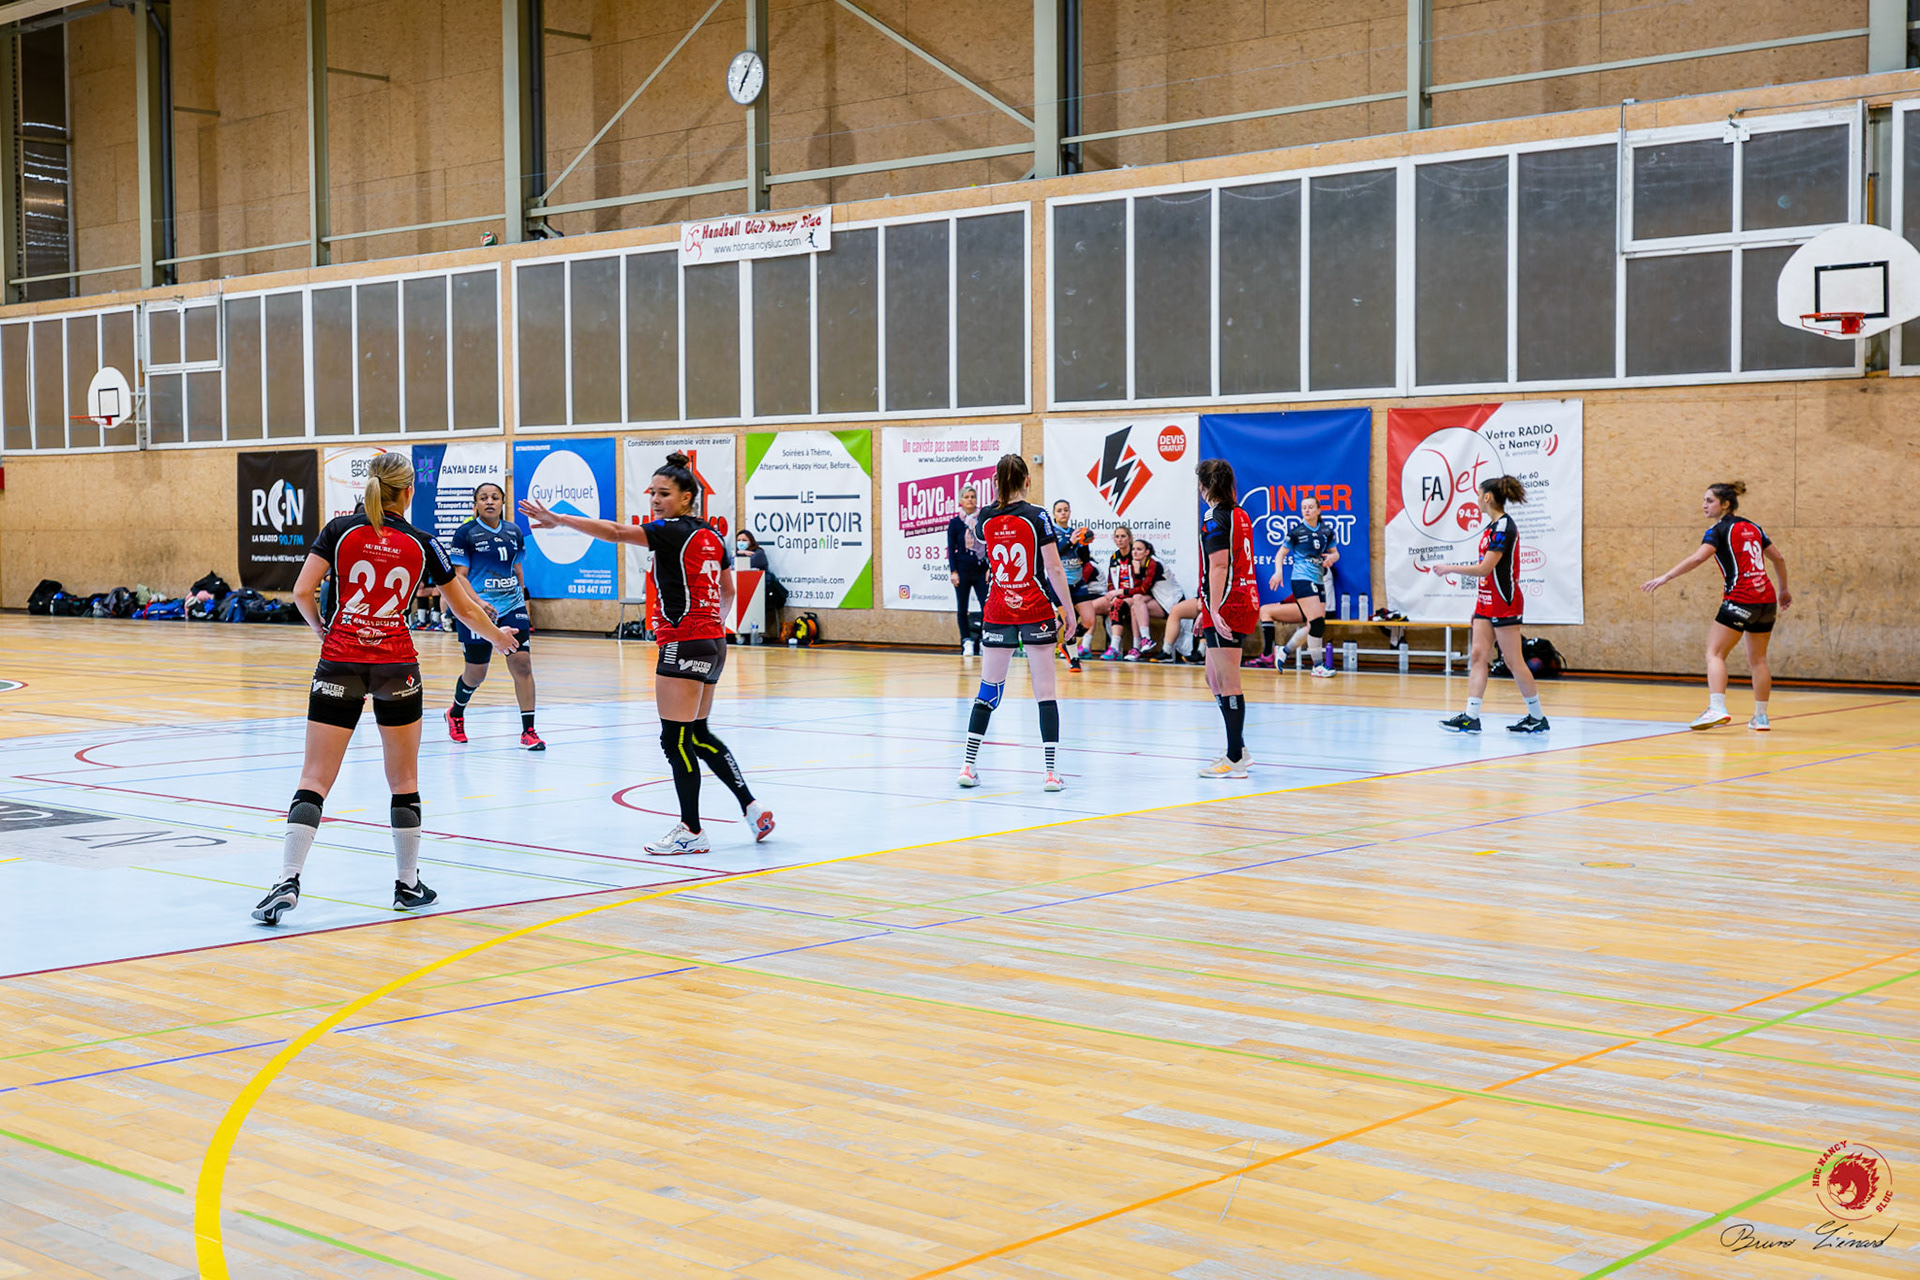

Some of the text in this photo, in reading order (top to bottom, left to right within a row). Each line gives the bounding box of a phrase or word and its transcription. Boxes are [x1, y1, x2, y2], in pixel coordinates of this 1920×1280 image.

[702, 220, 740, 240] Handball
[745, 220, 766, 234] Club
[714, 237, 802, 254] www.hbcnancysluc.com
[1486, 424, 1553, 440] Votre RADIO
[912, 438, 933, 452] caviste
[935, 440, 945, 453] pas
[947, 440, 968, 452] comme
[970, 438, 979, 451] les
[980, 438, 1000, 450] autres
[1160, 435, 1184, 445] DEVIS
[1499, 440, 1540, 449] à Nancy
[782, 449, 804, 457] Soirées
[918, 455, 984, 463] www.lacavedeleon.fr
[352, 468, 368, 477] SPO
[442, 465, 498, 474] RAYAN DEM 54
[759, 462, 791, 471] Afterwork,
[792, 462, 811, 470] Happy
[532, 484, 593, 502] Guy Hoquet
[1422, 476, 1444, 501] FA
[800, 491, 814, 504] LE
[901, 504, 907, 521] la
[907, 482, 944, 520] Cave
[946, 496, 955, 512] de
[1270, 484, 1352, 512] INTER
[252, 478, 304, 533] RCN
[1458, 508, 1479, 518] 94.2
[754, 512, 862, 533] COMPTOIR
[1070, 518, 1171, 530] HelloHomeLorraine
[1266, 515, 1356, 546] SPRT
[259, 534, 278, 542] RADIO
[278, 534, 293, 545] 90.7
[777, 535, 839, 554] Campanile
[1314, 540, 1320, 549] 6
[498, 546, 508, 561] 11
[907, 546, 921, 559] 03
[925, 546, 940, 559] 83
[1408, 544, 1454, 554] Programmes
[342, 560, 410, 618] 22
[568, 585, 612, 594] 03 83 447 077
[788, 590, 834, 600] 3.57.29.10.07
[692, 660, 712, 669] INTER
[322, 682, 345, 692] INTER
[322, 688, 343, 697] SPORT
